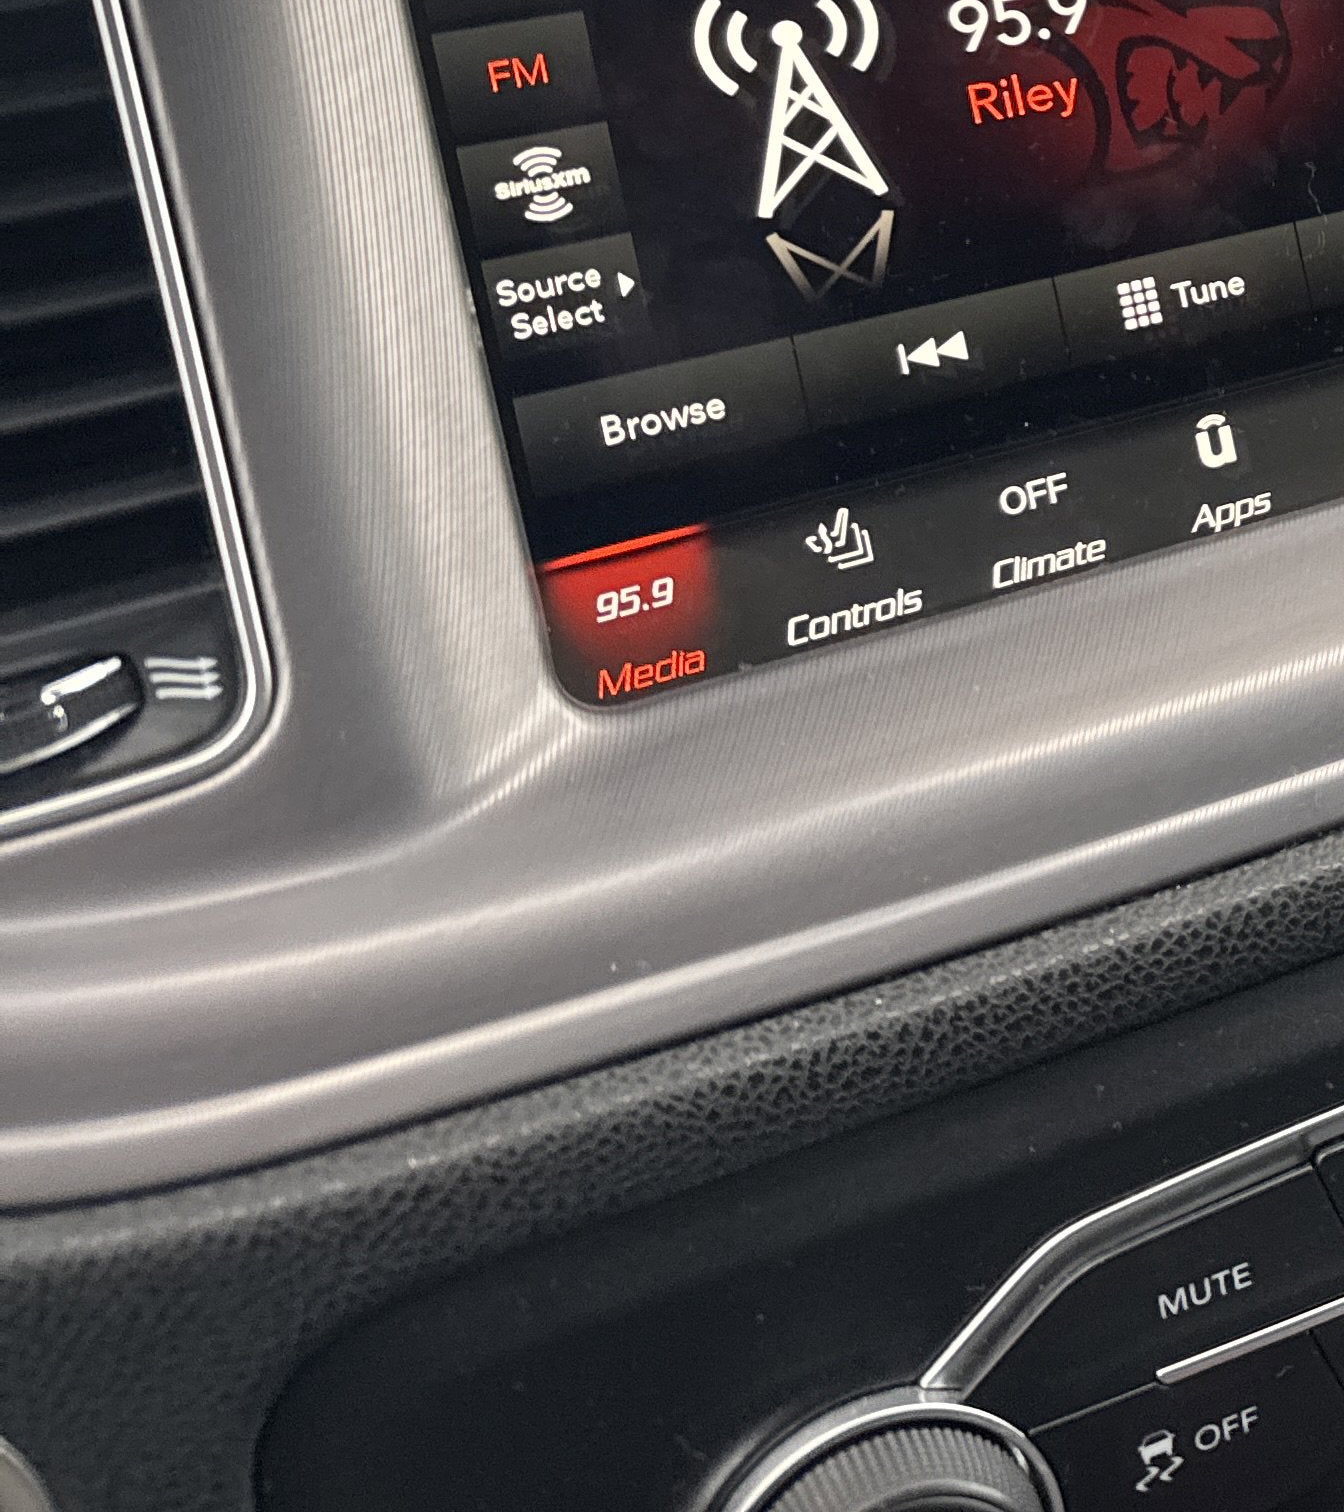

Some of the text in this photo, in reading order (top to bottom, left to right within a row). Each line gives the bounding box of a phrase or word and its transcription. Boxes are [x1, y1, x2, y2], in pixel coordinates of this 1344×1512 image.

[486, 52, 550, 93] FM
[967, 74, 1079, 125] Riley
[495, 265, 602, 308] Source
[1168, 271, 1246, 309] Tune
[510, 300, 606, 341] Select
[600, 397, 727, 447] Browse
[999, 471, 1068, 515] OFF
[1190, 491, 1273, 533] Apps
[991, 538, 1108, 590] Climate
[594, 576, 675, 626] 95.9
[786, 588, 924, 647] Controls
[597, 648, 706, 701] Media
[1157, 1261, 1254, 1319] MUTE
[1194, 1405, 1259, 1451] OFF
